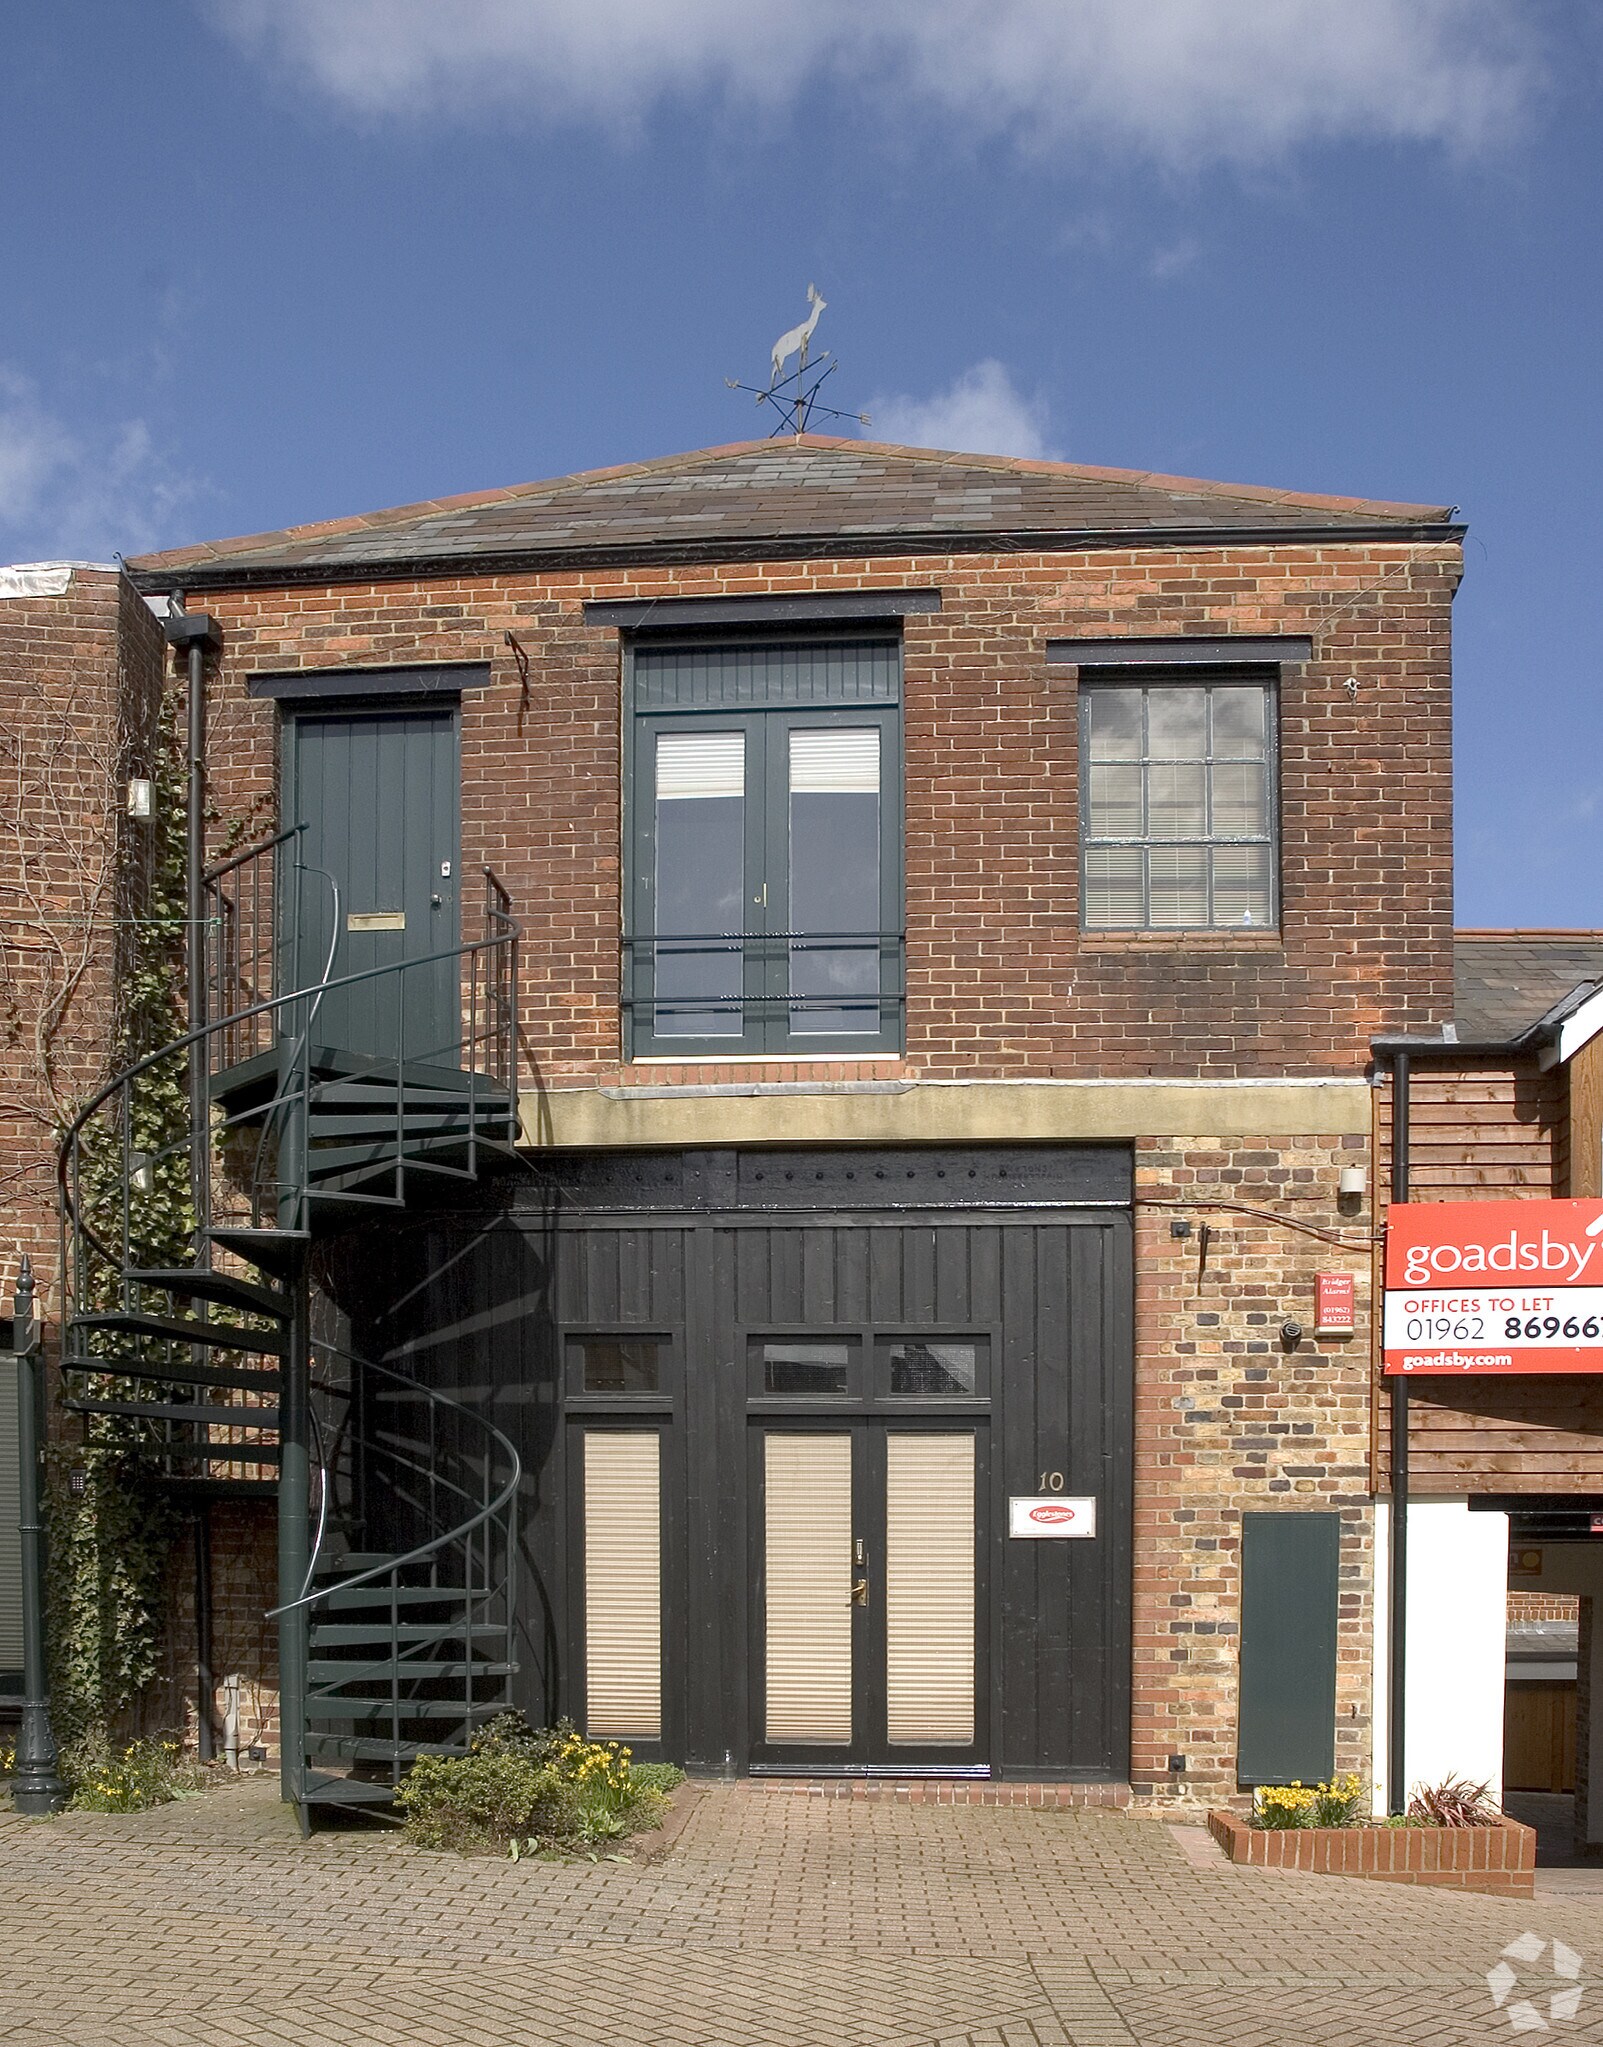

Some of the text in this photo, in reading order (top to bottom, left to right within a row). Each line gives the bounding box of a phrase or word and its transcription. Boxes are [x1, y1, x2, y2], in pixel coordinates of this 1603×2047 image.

[1404, 1229, 1597, 1285] goadsby
[1404, 1297, 1554, 1313] OFFICES TO LET
[1407, 1315, 1603, 1341] 01962 86966
[1402, 1351, 1513, 1371] goadsby.com
[1038, 1471, 1064, 1492] 10
